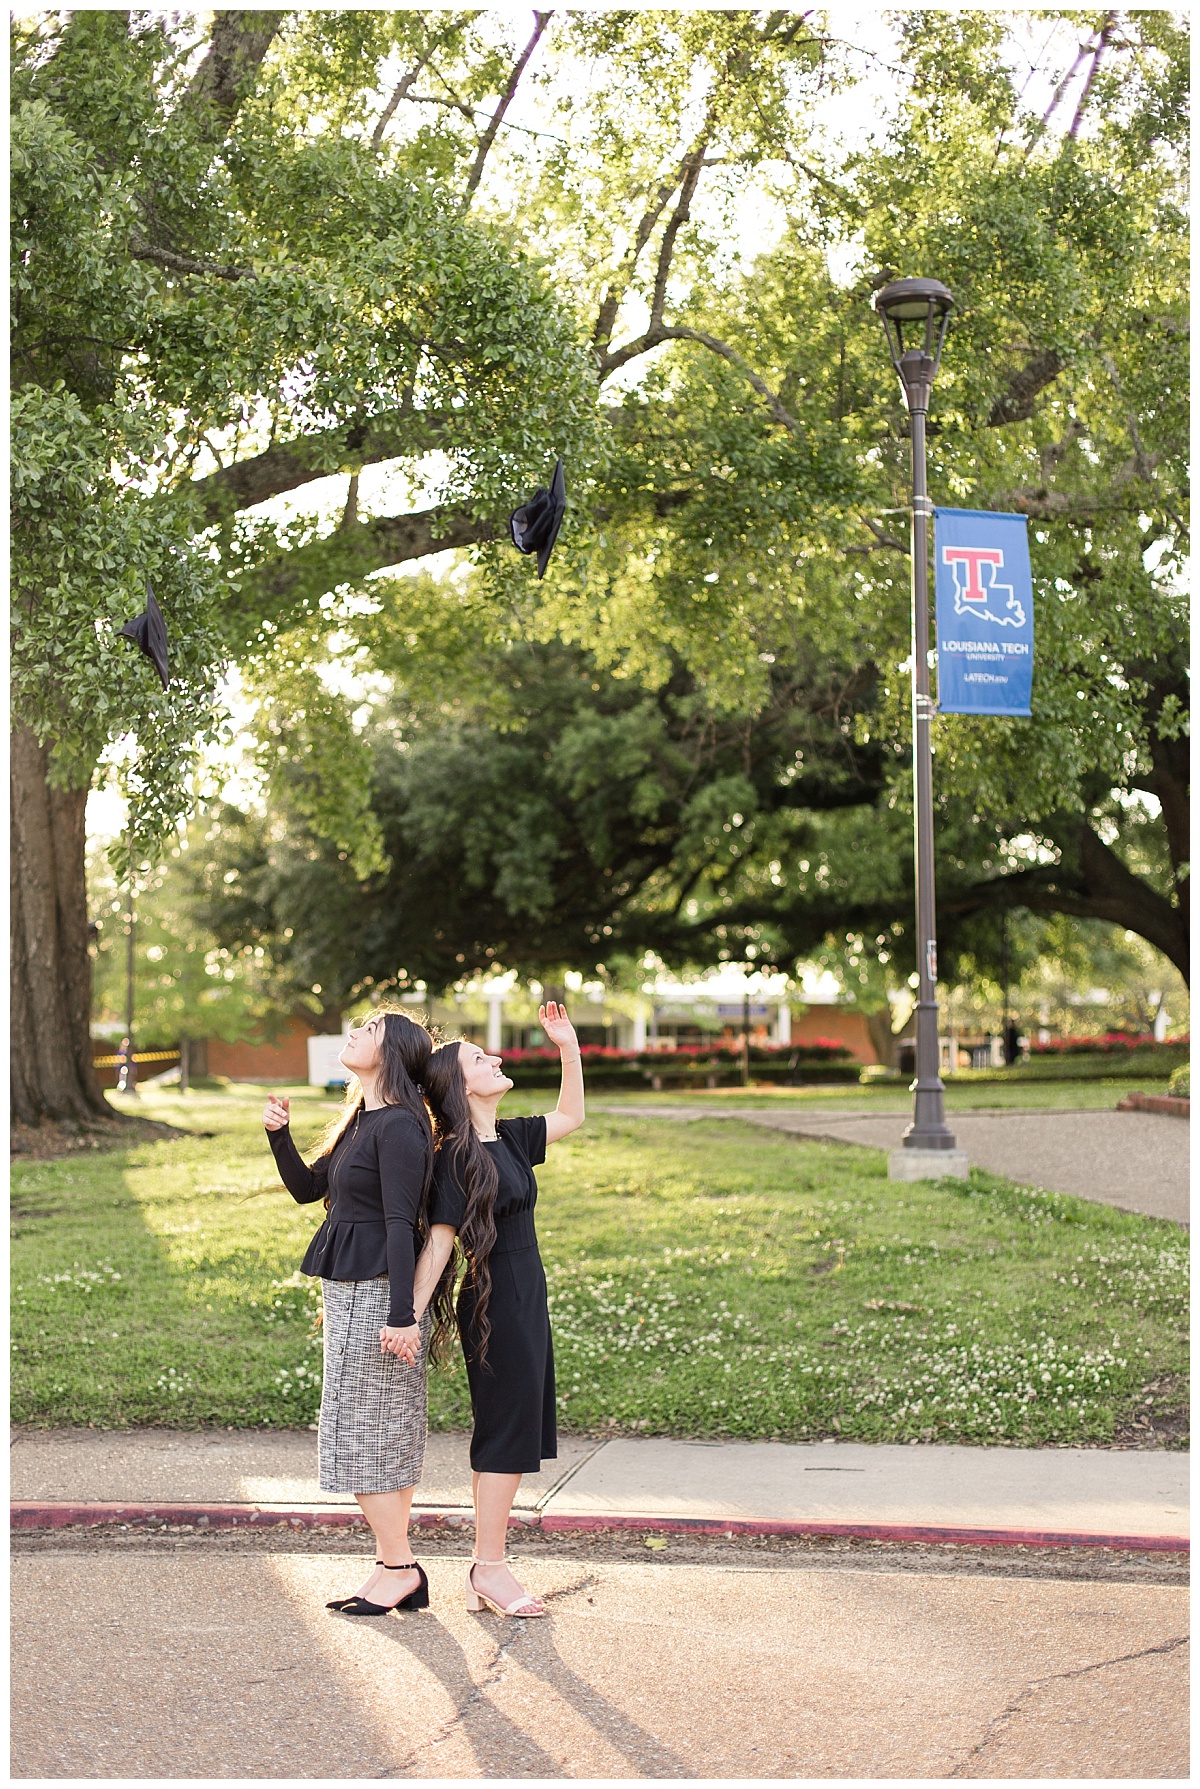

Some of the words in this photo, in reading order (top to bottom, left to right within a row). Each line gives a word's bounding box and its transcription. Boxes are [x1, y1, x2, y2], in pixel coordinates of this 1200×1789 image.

[942, 546, 1004, 602] T
[942, 640, 1000, 653] LOUISIANA
[1001, 642, 1029, 654] TECH
[966, 653, 1005, 661] UNIVERSITY
